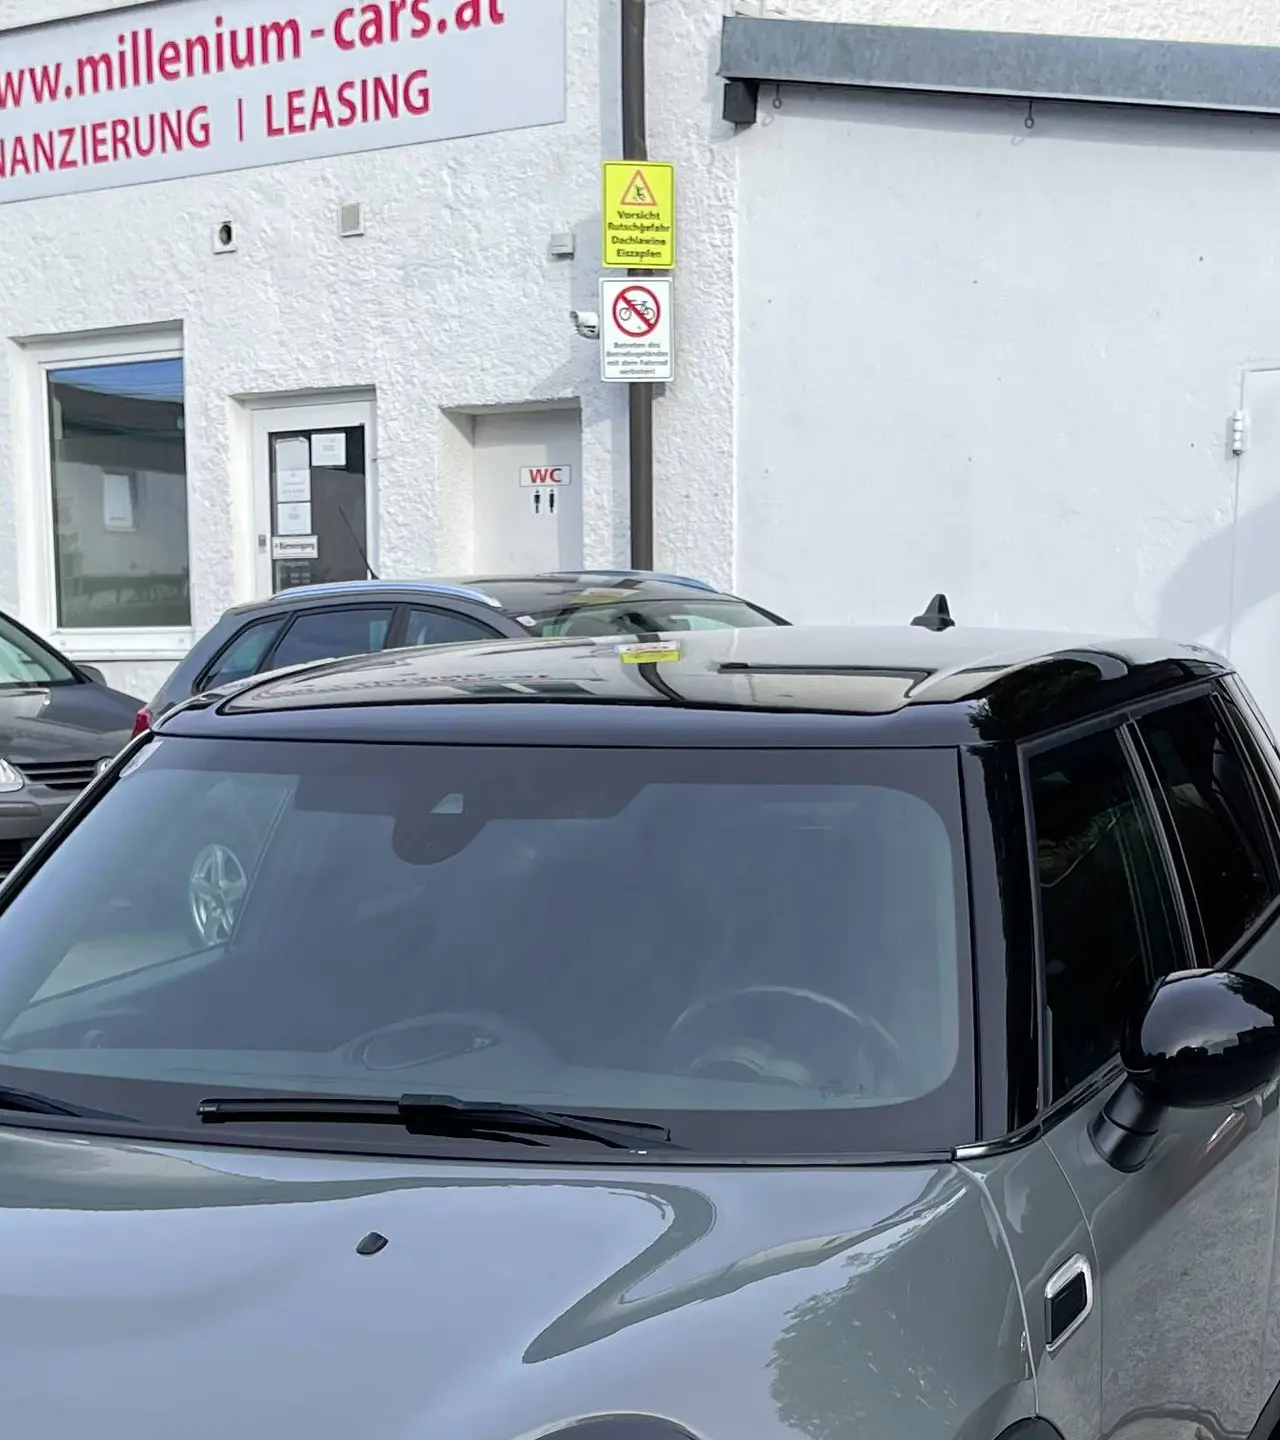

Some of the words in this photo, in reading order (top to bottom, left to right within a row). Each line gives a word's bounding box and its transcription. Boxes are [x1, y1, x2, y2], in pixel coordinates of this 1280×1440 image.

[265, 69, 431, 138] LEASING
[616, 210, 661, 220] Vorsicht
[529, 468, 562, 483] WC
